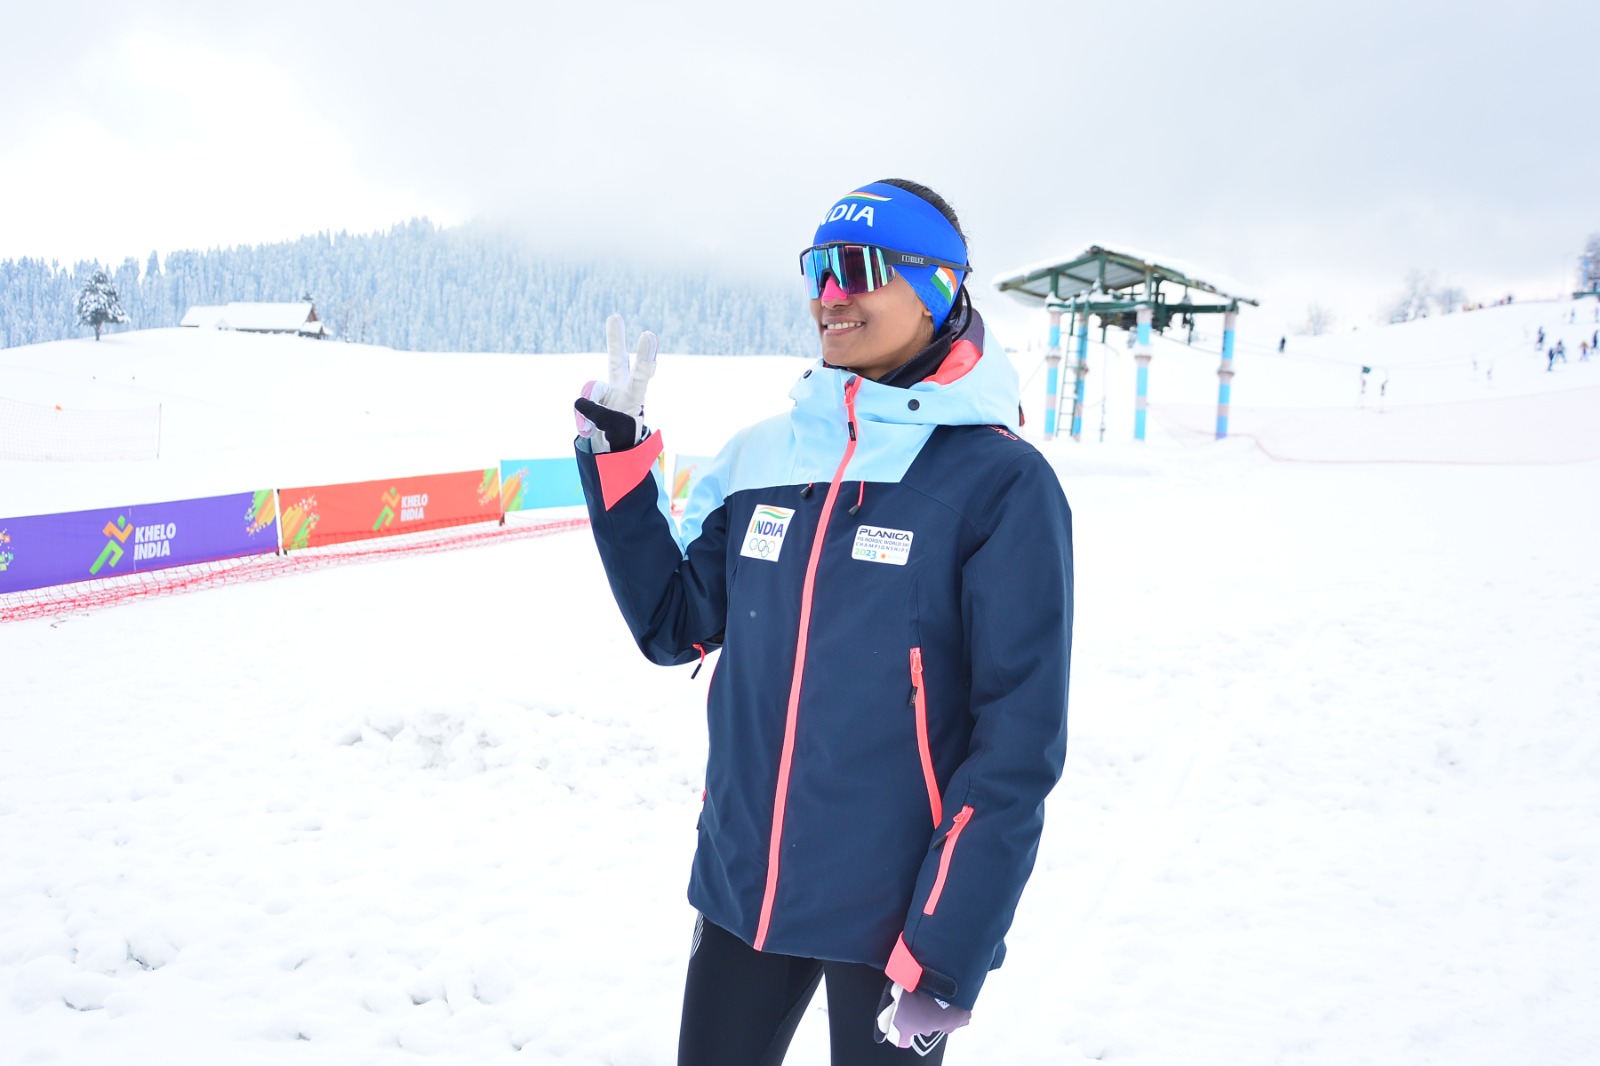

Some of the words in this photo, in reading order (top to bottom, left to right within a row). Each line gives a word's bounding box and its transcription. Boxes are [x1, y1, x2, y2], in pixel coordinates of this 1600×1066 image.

[401, 493, 428, 508] KHELO
[400, 507, 424, 522] INDIA
[134, 522, 177, 543] KHELO
[750, 519, 784, 538] INDIA
[859, 528, 910, 541] PLANICA
[133, 540, 171, 560] INDIA
[854, 548, 877, 559] 2023
[855, 542, 908, 553] CHAMPIONSHIPS
